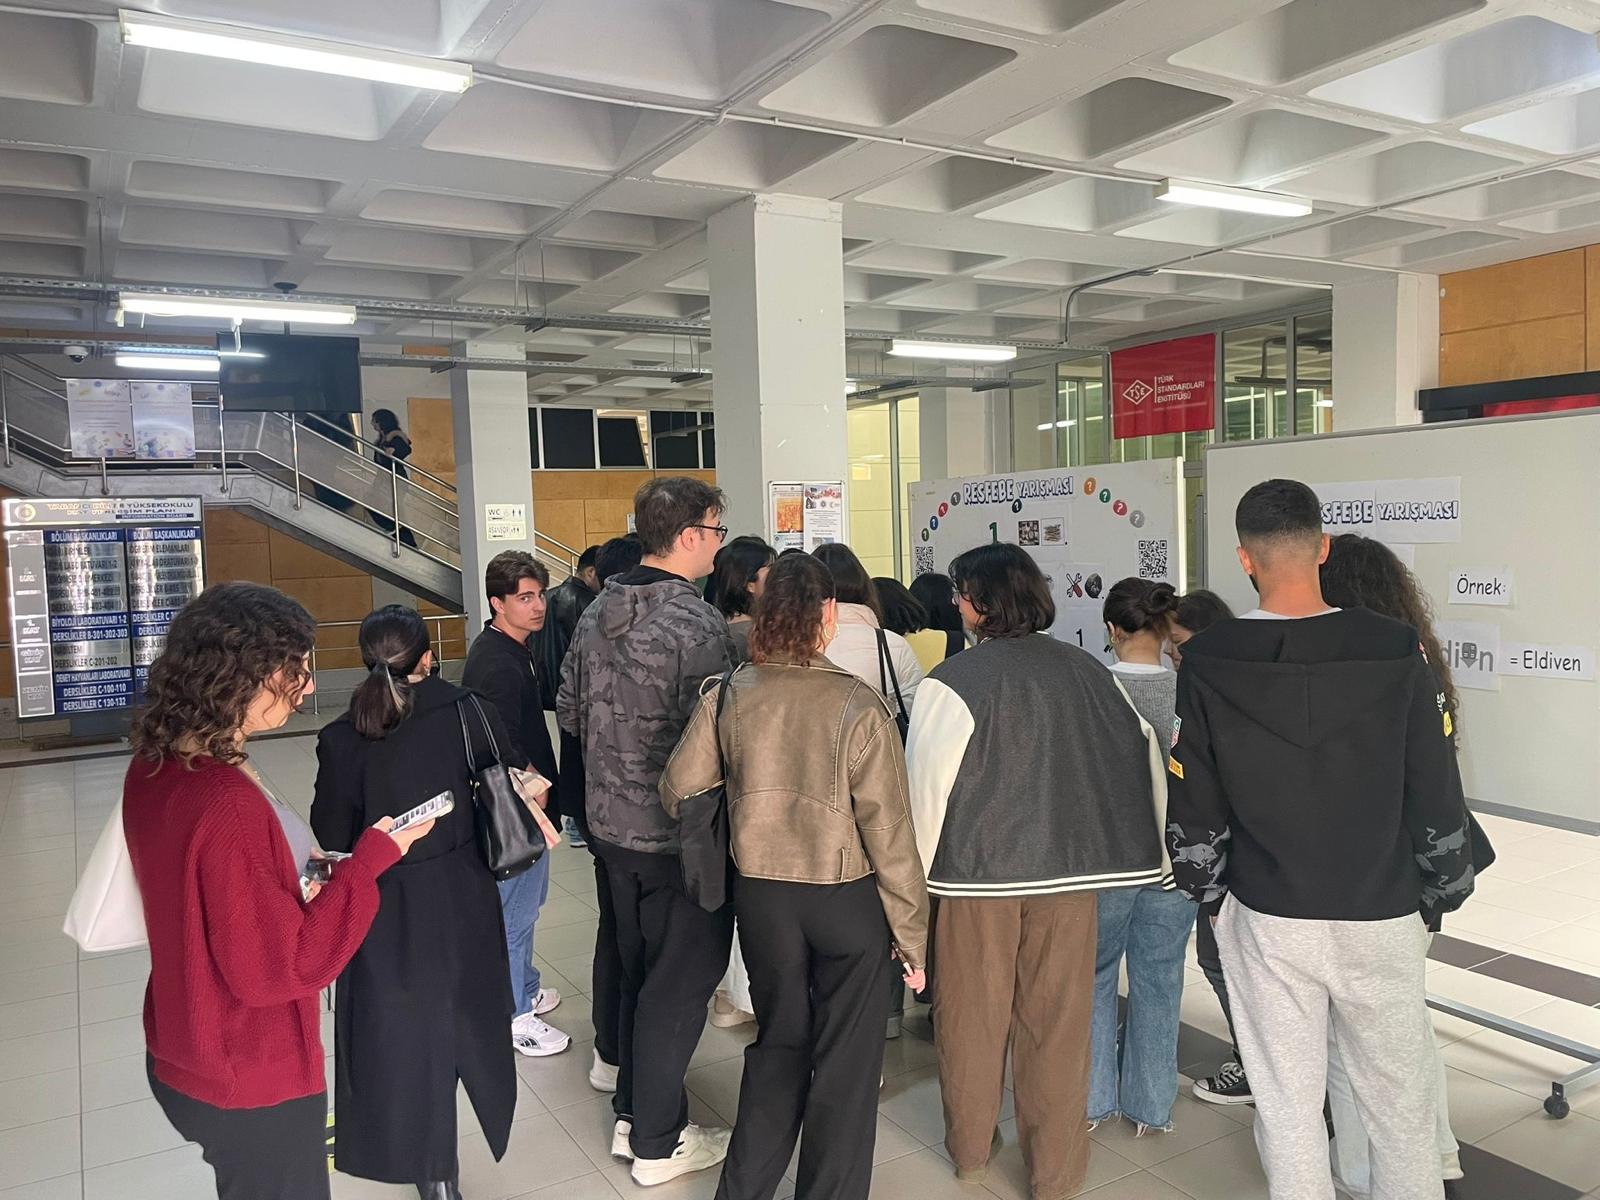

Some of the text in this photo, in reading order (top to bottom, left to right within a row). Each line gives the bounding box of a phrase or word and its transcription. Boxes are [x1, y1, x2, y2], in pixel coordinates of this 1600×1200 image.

[1158, 375, 1174, 384] TÜRK
[1130, 385, 1145, 400] TSE
[1158, 381, 1205, 394] STANDARDLARI
[963, 476, 1074, 505] RESFEBE YARIŞMASI
[1320, 500, 1459, 525] SFEBE YARIŞMASI
[51, 531, 72, 542] BÖLÜM
[154, 529, 196, 541] BAŞKANLIKLARI
[1456, 574, 1507, 595] Örnek:
[52, 614, 127, 627] BİYOLOJİ LABORATUVARI 1-2
[133, 612, 165, 623] DERSLİKLER
[53, 630, 86, 641] DERSLİKLER
[87, 628, 128, 640] B-301-302-303
[1076, 628, 1083, 648] 1
[55, 656, 118, 669] DERSLİKLER C-201-202
[1523, 650, 1581, 672] Eldiven
[63, 683, 127, 697] DERSLİKLER C-100-110
[63, 699, 97, 711] DERSLİKLER
[103, 697, 126, 707] 130-132
